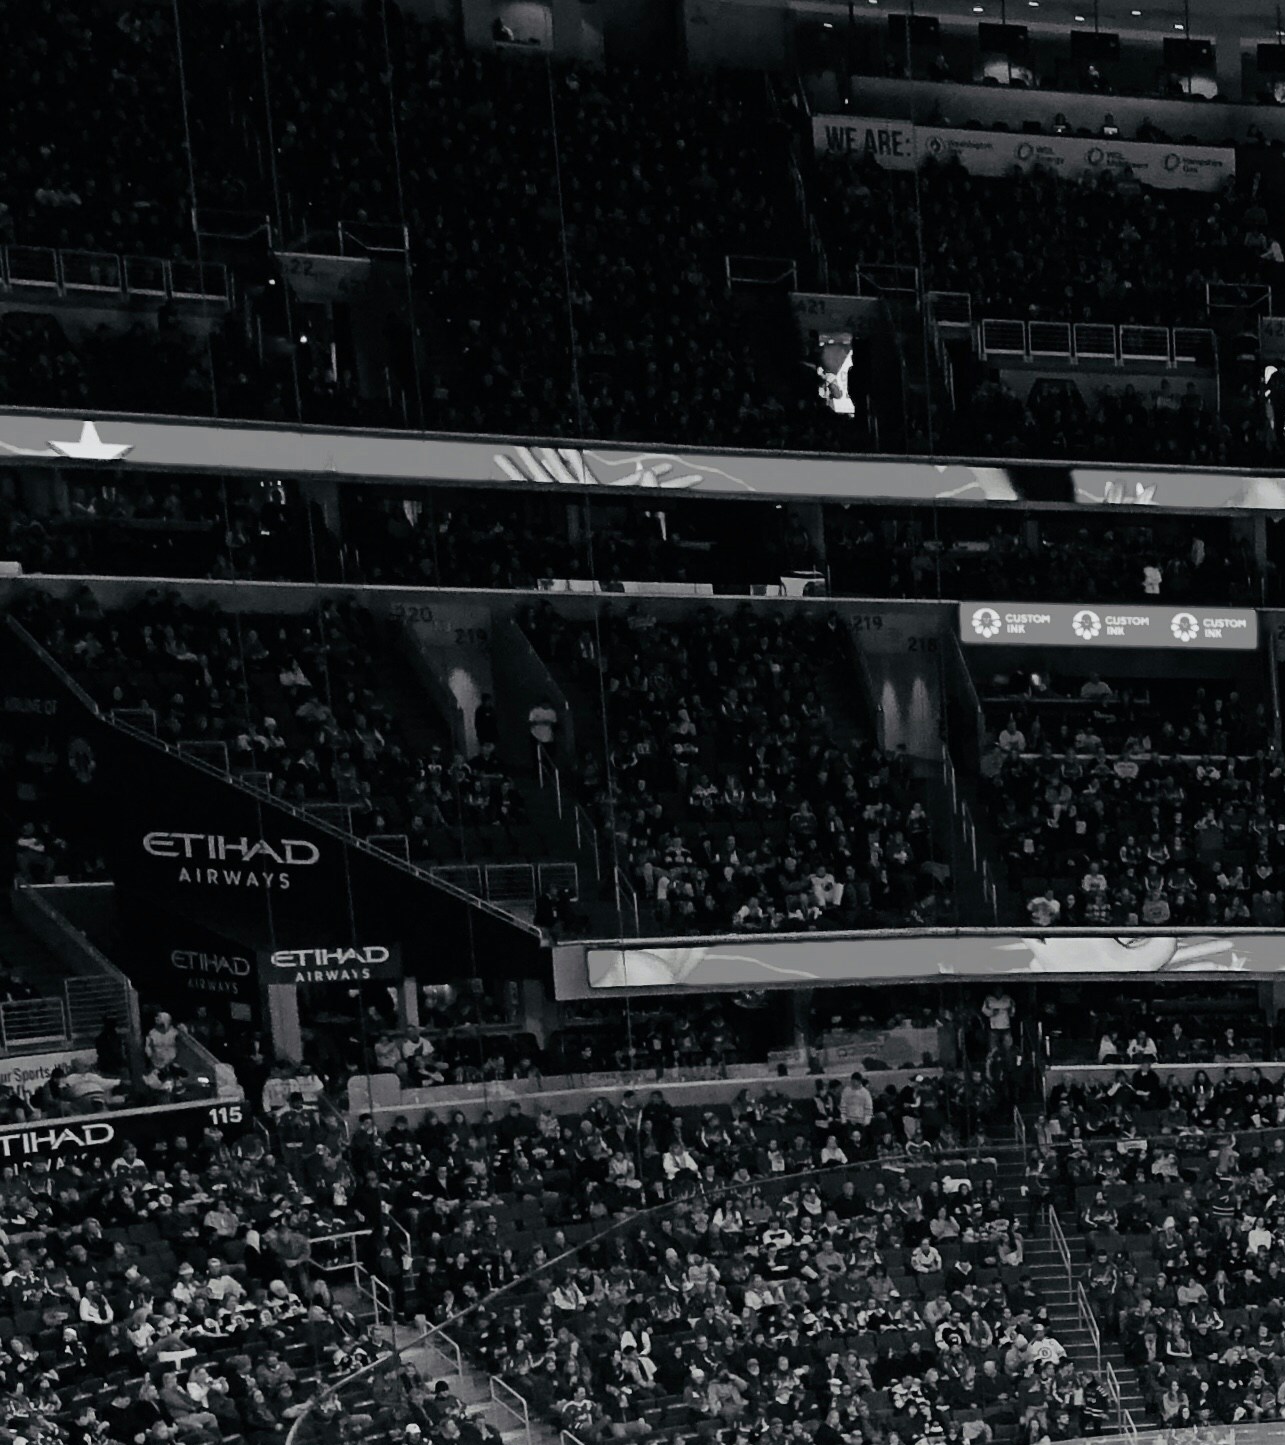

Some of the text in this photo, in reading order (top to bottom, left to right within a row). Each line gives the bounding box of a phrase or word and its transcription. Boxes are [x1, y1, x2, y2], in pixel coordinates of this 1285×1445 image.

[825, 125, 912, 158] WE ARE:
[1005, 614, 1247, 630] CUSTOM CUSTOM CUSTOM
[1006, 625, 1223, 639] INK INK INK
[142, 831, 320, 865] ETIHAD
[178, 866, 291, 890] AIRWAYS
[171, 950, 250, 976] ETIHAD
[270, 946, 390, 969] ETIHAD
[295, 966, 370, 983] AIRWAYS
[186, 977, 240, 995] AIRWAYS
[15, 1066, 50, 1082] Sports
[209, 1106, 242, 1125] 115
[0, 1123, 114, 1156] TIHAD
